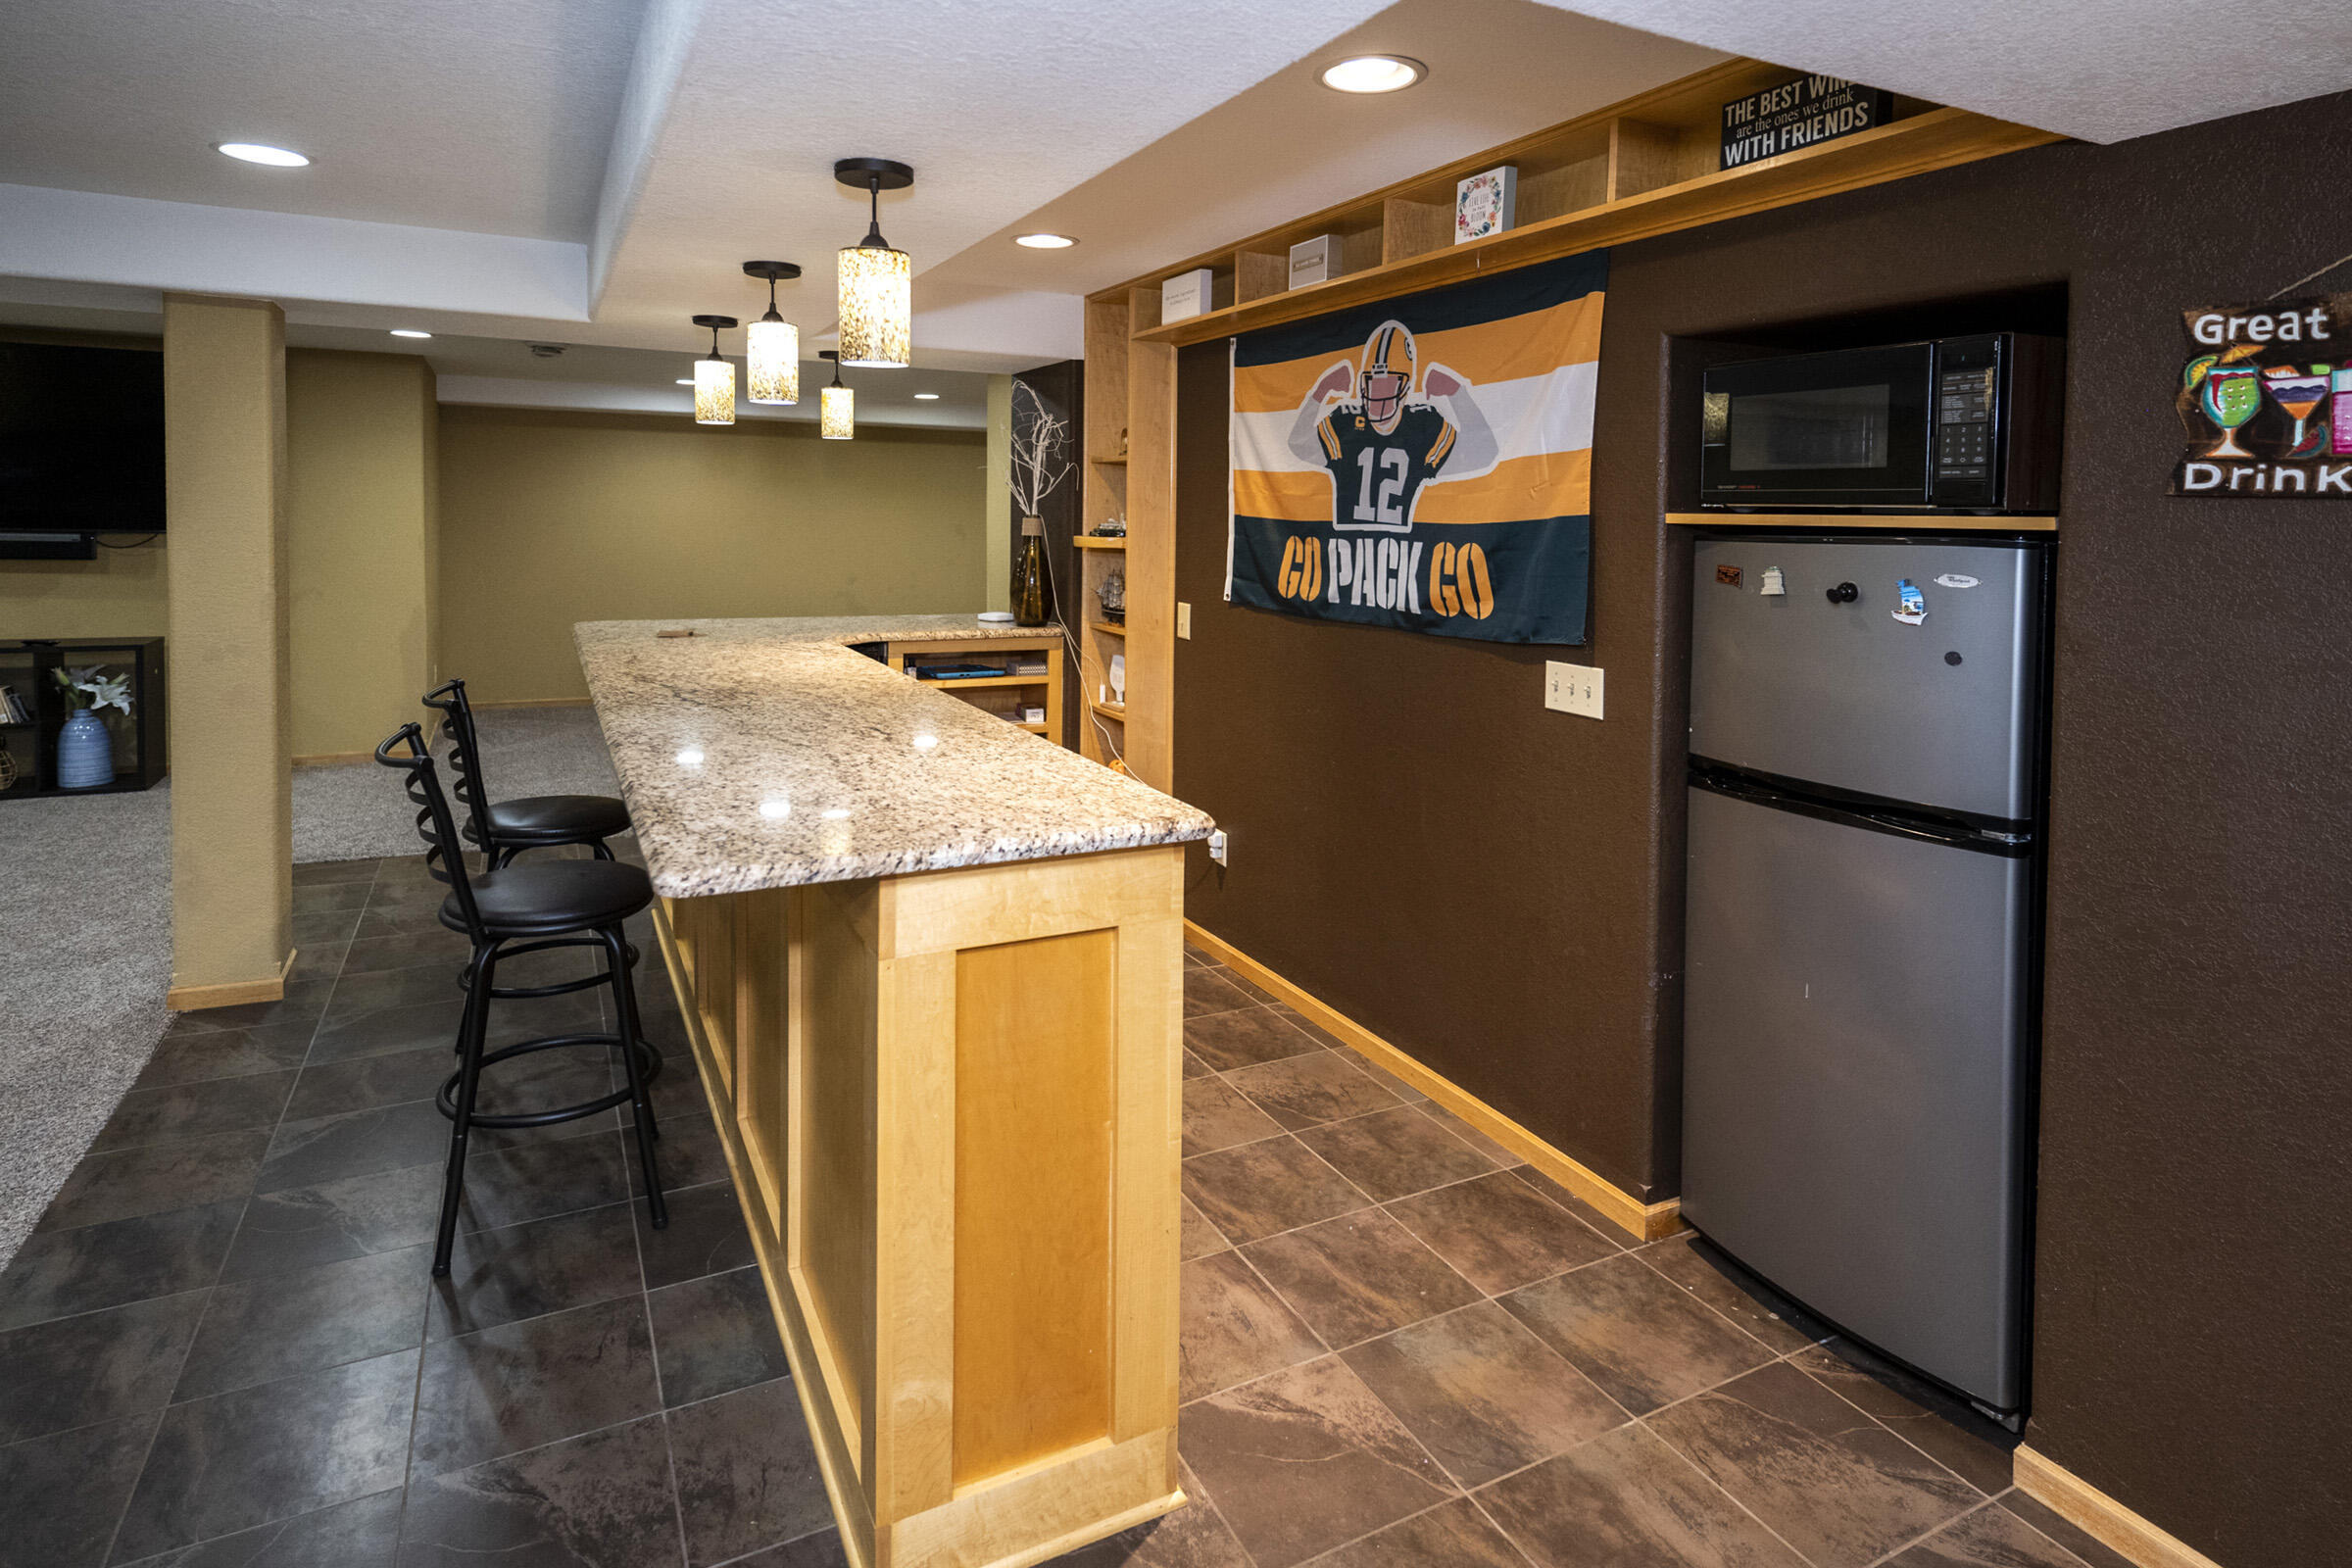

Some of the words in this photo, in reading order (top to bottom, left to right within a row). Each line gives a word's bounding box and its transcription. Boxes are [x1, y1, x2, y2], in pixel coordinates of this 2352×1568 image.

[1725, 98, 1756, 127] THE
[1760, 80, 1803, 117] BEST
[1808, 75, 1859, 98] WIN
[1737, 126, 1751, 139] are
[1755, 117, 1772, 132] the
[1774, 109, 1799, 126] ones
[1802, 102, 1820, 117] we
[1822, 87, 1855, 111] drink
[1725, 130, 1775, 167] WITH
[1781, 101, 1869, 150] FRIENDS
[2193, 308, 2331, 344] Great
[1353, 447, 1409, 524] 12
[1278, 535, 1322, 603] GO
[1328, 538, 1423, 614] PACK
[1430, 541, 1494, 620] GO
